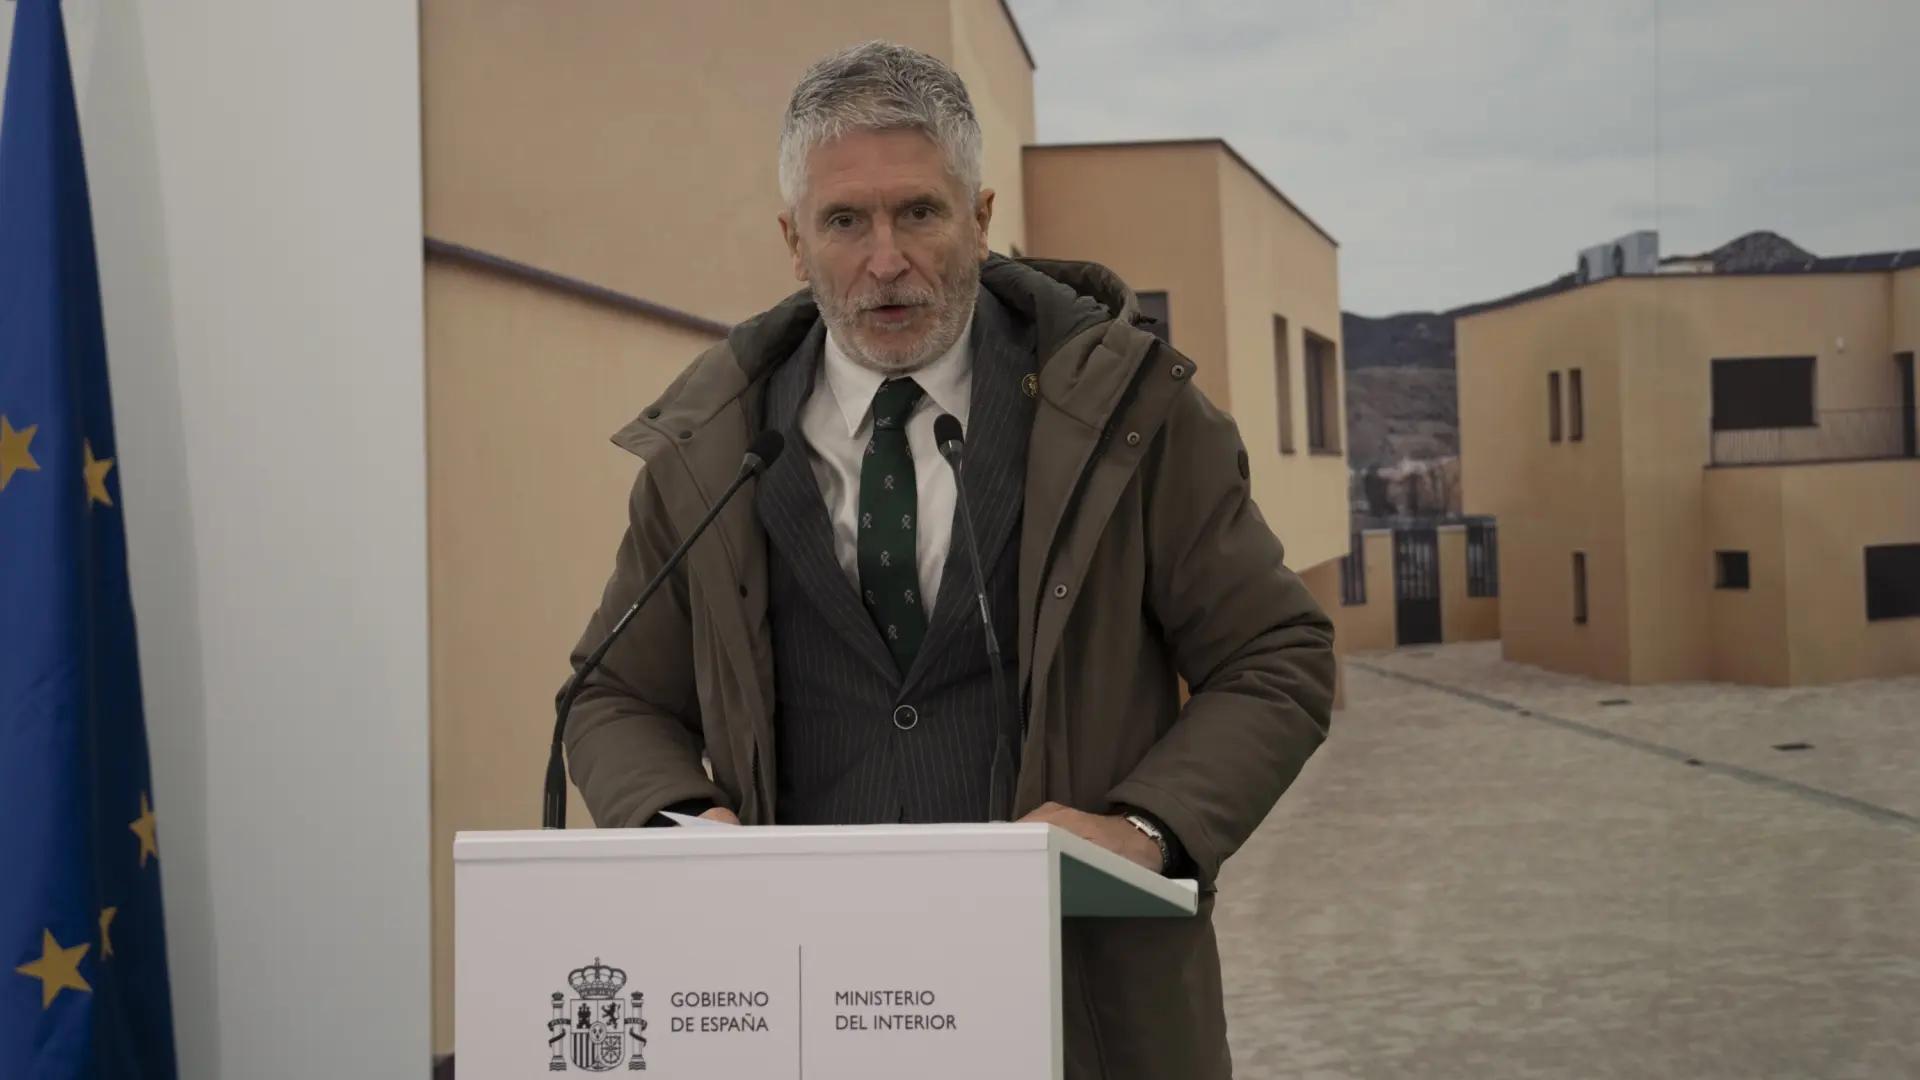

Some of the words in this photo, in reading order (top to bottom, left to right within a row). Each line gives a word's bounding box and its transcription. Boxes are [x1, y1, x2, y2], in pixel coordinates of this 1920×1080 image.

[670, 991, 769, 1008] GOBIERNO
[835, 990, 935, 1006] MINISTERIO
[671, 1016, 694, 1033] DE
[701, 1012, 769, 1033] ESPAÑA
[835, 1015, 868, 1031] DEL
[873, 1014, 957, 1031] INTERIOR
